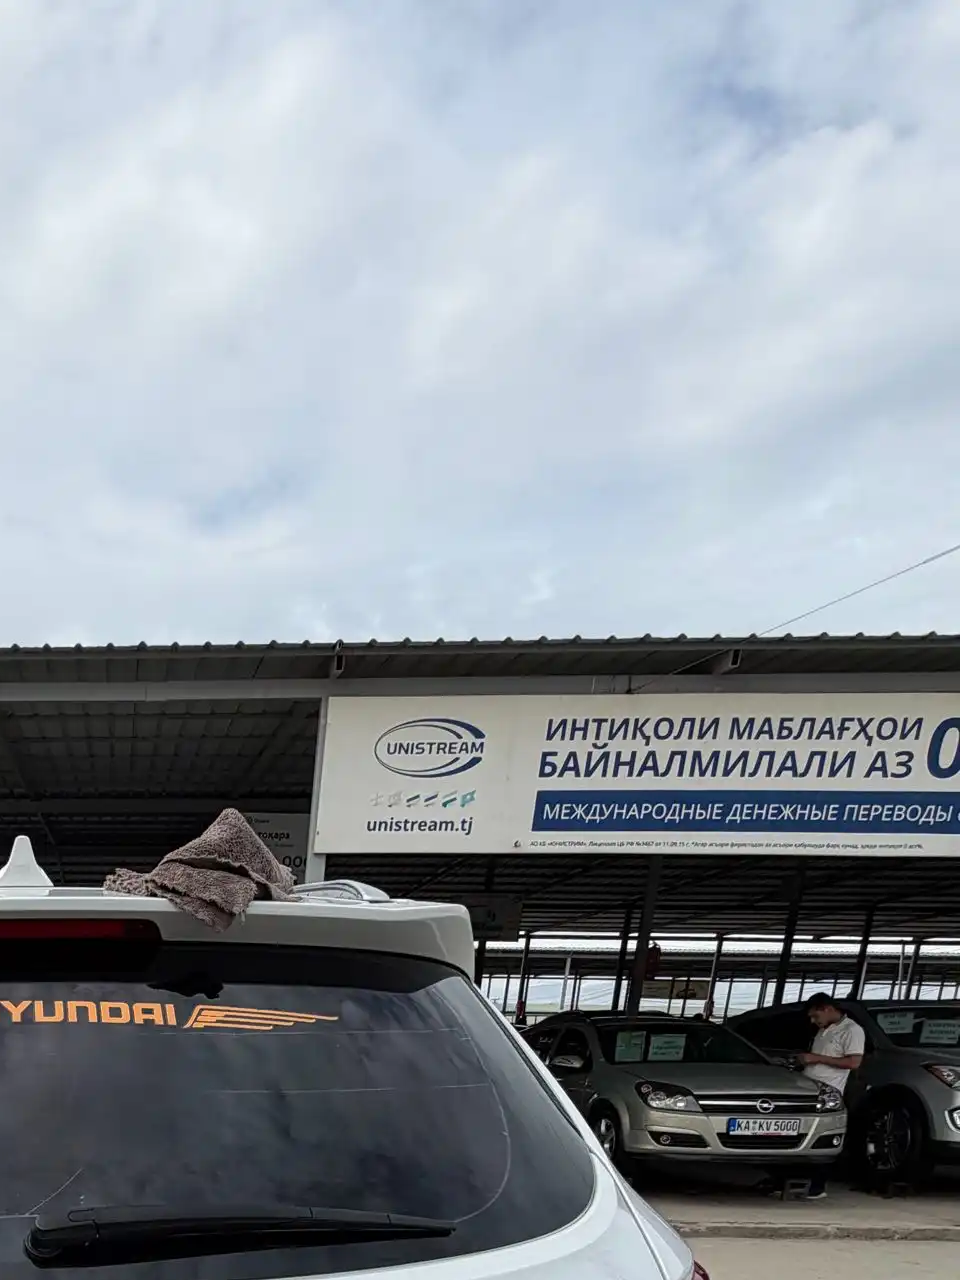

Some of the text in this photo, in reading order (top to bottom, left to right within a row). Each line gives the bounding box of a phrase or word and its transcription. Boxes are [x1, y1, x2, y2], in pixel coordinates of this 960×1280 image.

[545, 716, 924, 746] ИНТИҚОЛИ МАБЛАҒҲОИ
[386, 741, 485, 755] UNISTREAM
[538, 743, 915, 778] БАЙНАЛМИЛАЛИ АЗ
[543, 803, 723, 823] МЕЖДУНАРОДНЫЕ
[726, 803, 839, 824] ДЕНЕЖНЫЕ
[843, 804, 953, 825] ПЕРЕВОДЫ
[366, 816, 473, 835] unistream.tj
[737, 1120, 798, 1132] KA KV 5000
